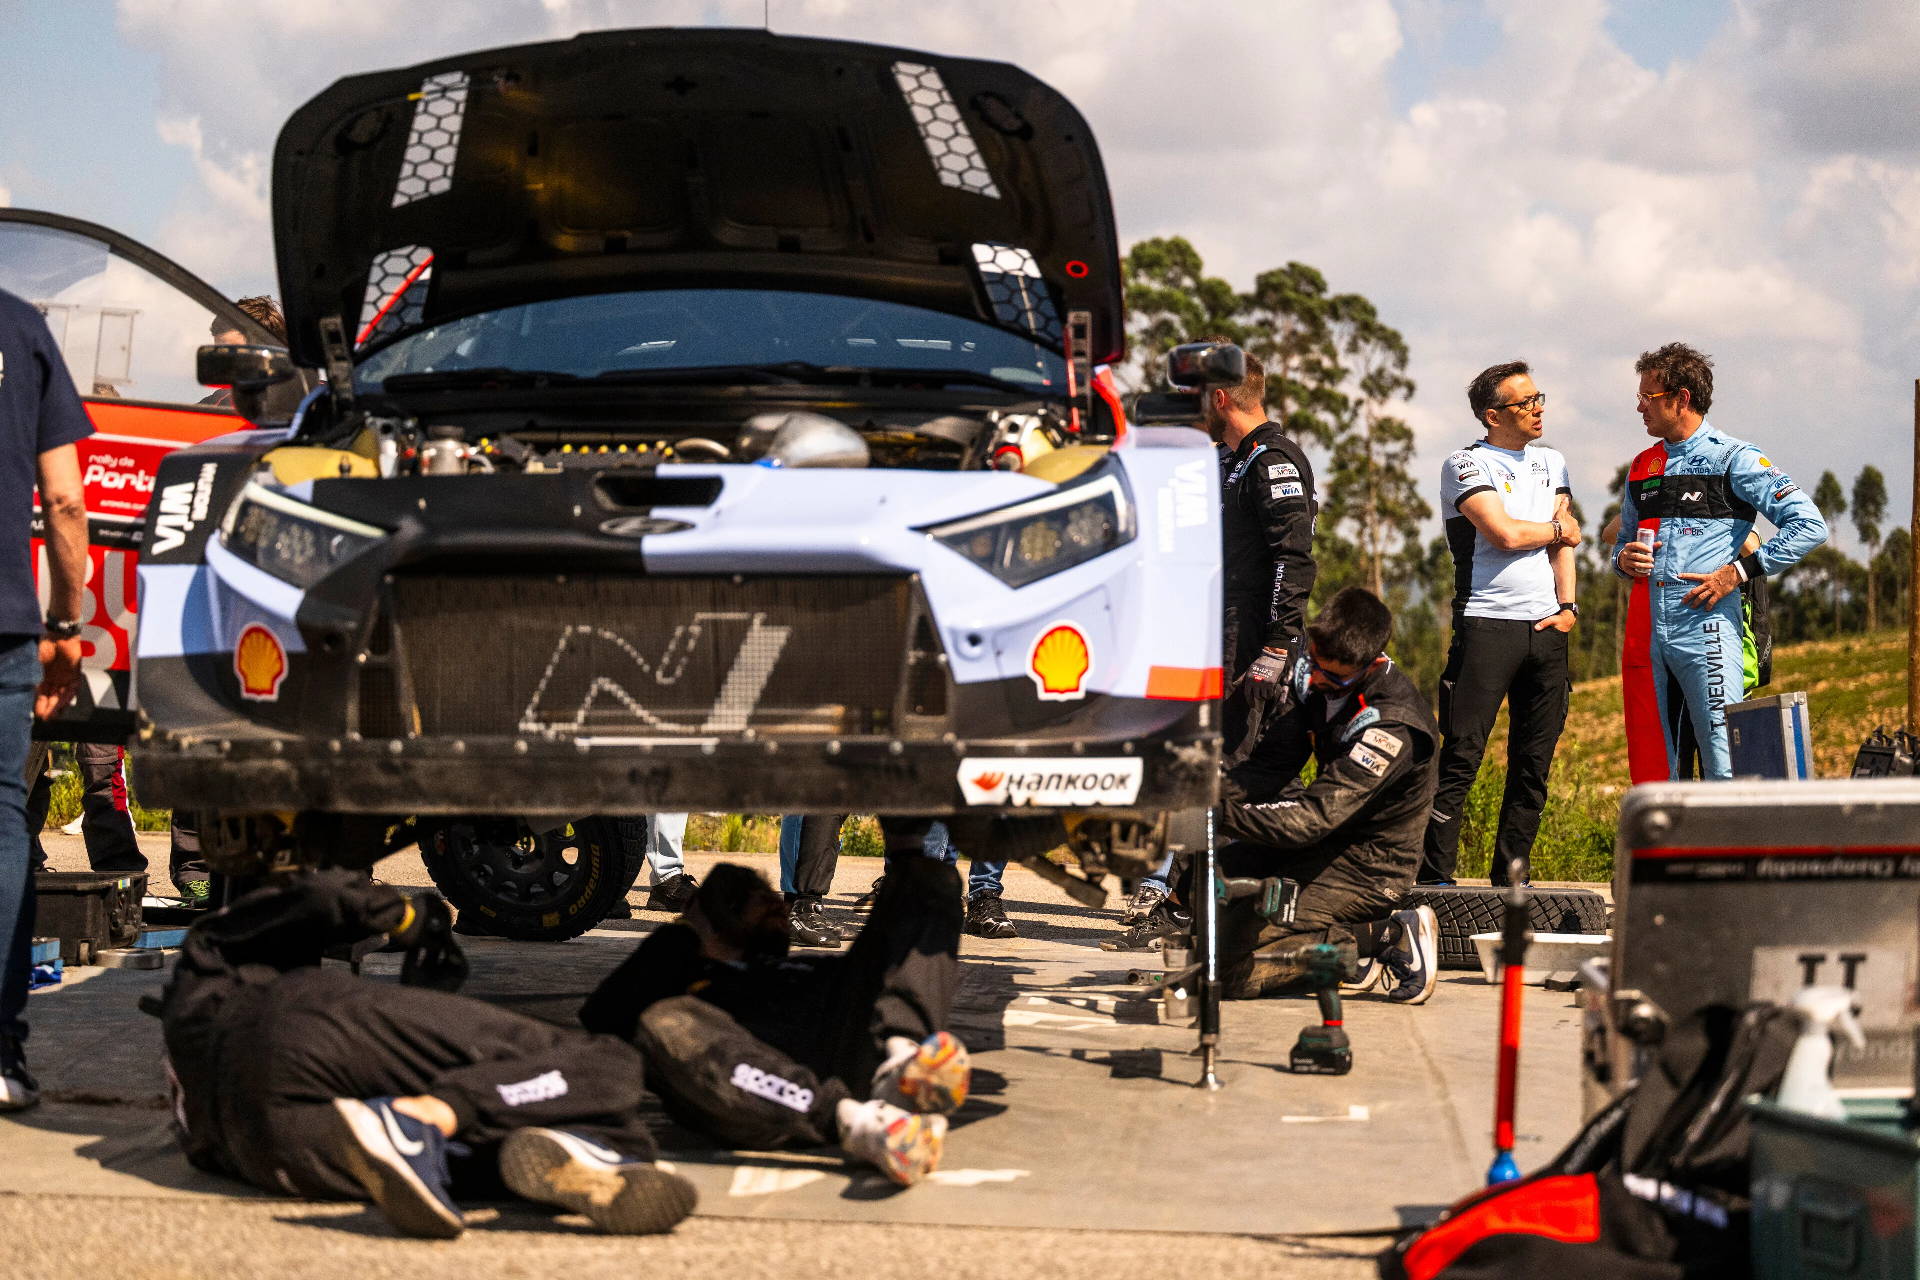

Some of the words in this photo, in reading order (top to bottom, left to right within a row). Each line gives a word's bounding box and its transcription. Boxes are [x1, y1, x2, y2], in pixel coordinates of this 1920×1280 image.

[88, 454, 118, 467] rally
[118, 456, 135, 467] de
[1281, 486, 1300, 495] WIA
[1677, 527, 1704, 535] MOBIS
